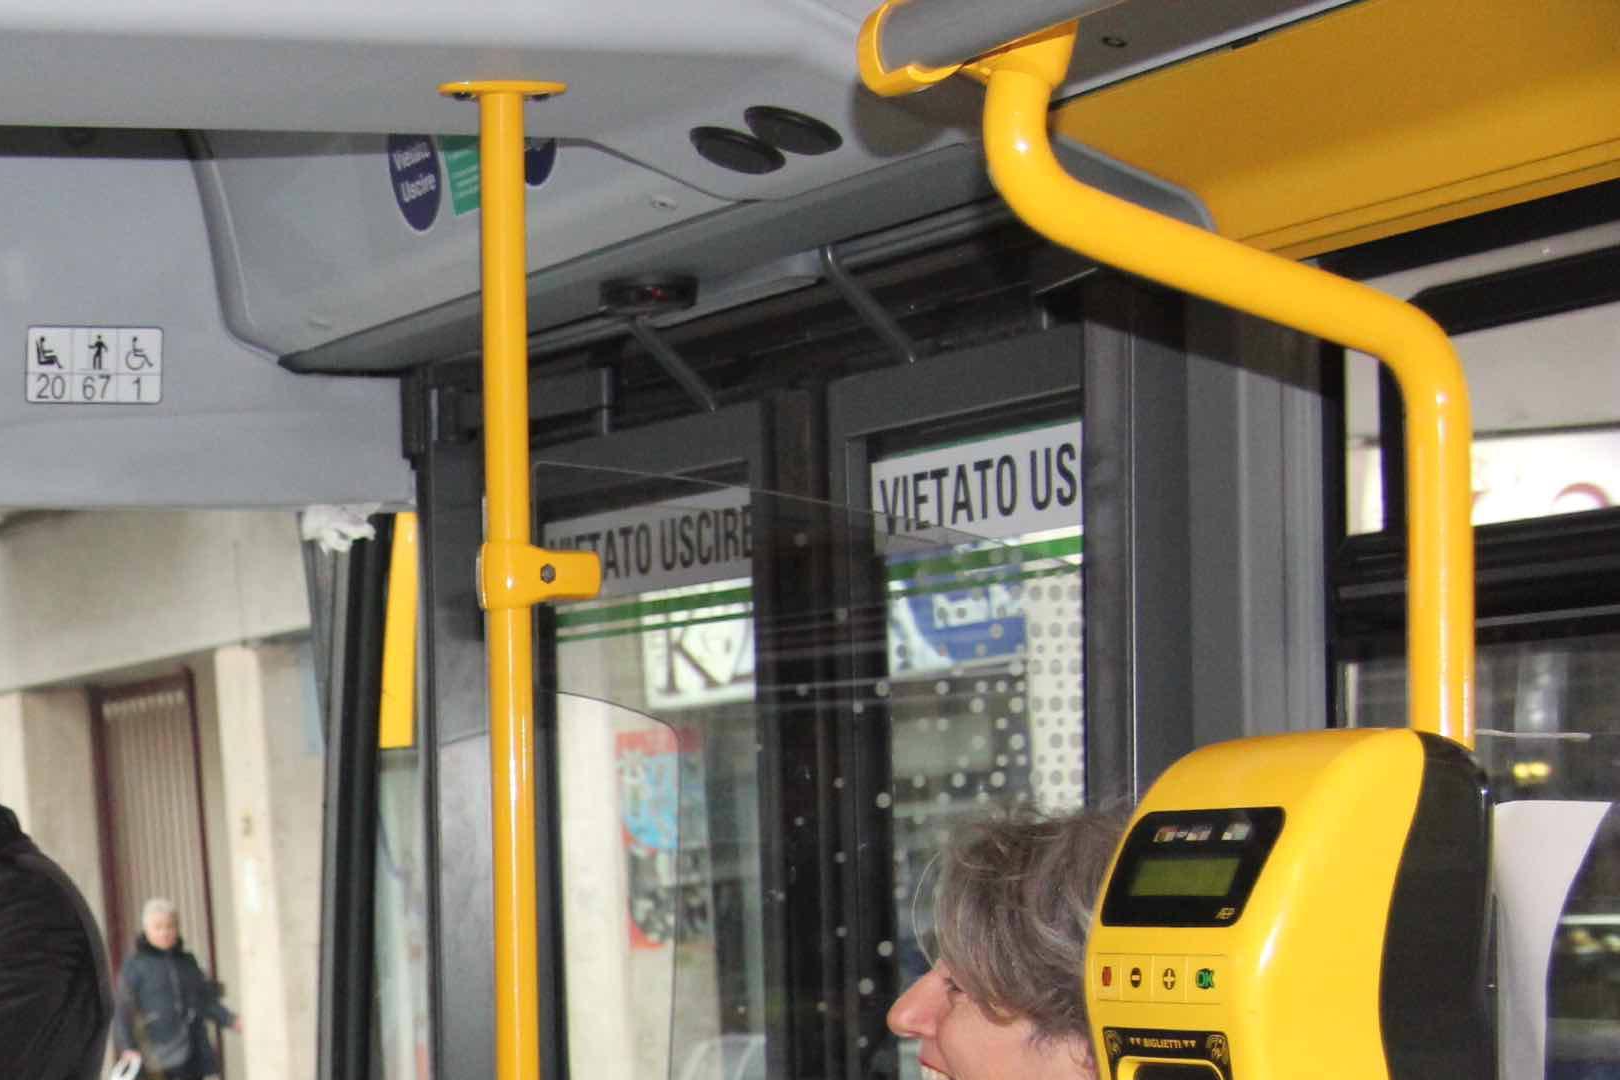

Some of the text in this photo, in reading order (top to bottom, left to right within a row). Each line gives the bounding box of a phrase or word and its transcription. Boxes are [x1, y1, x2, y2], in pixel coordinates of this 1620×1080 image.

[36, 373, 141, 400] 20 67 1
[880, 442, 1077, 536] VIETATO US
[659, 505, 753, 571] USCIRE
[1143, 1038, 1181, 1049] BIGLIETTI
